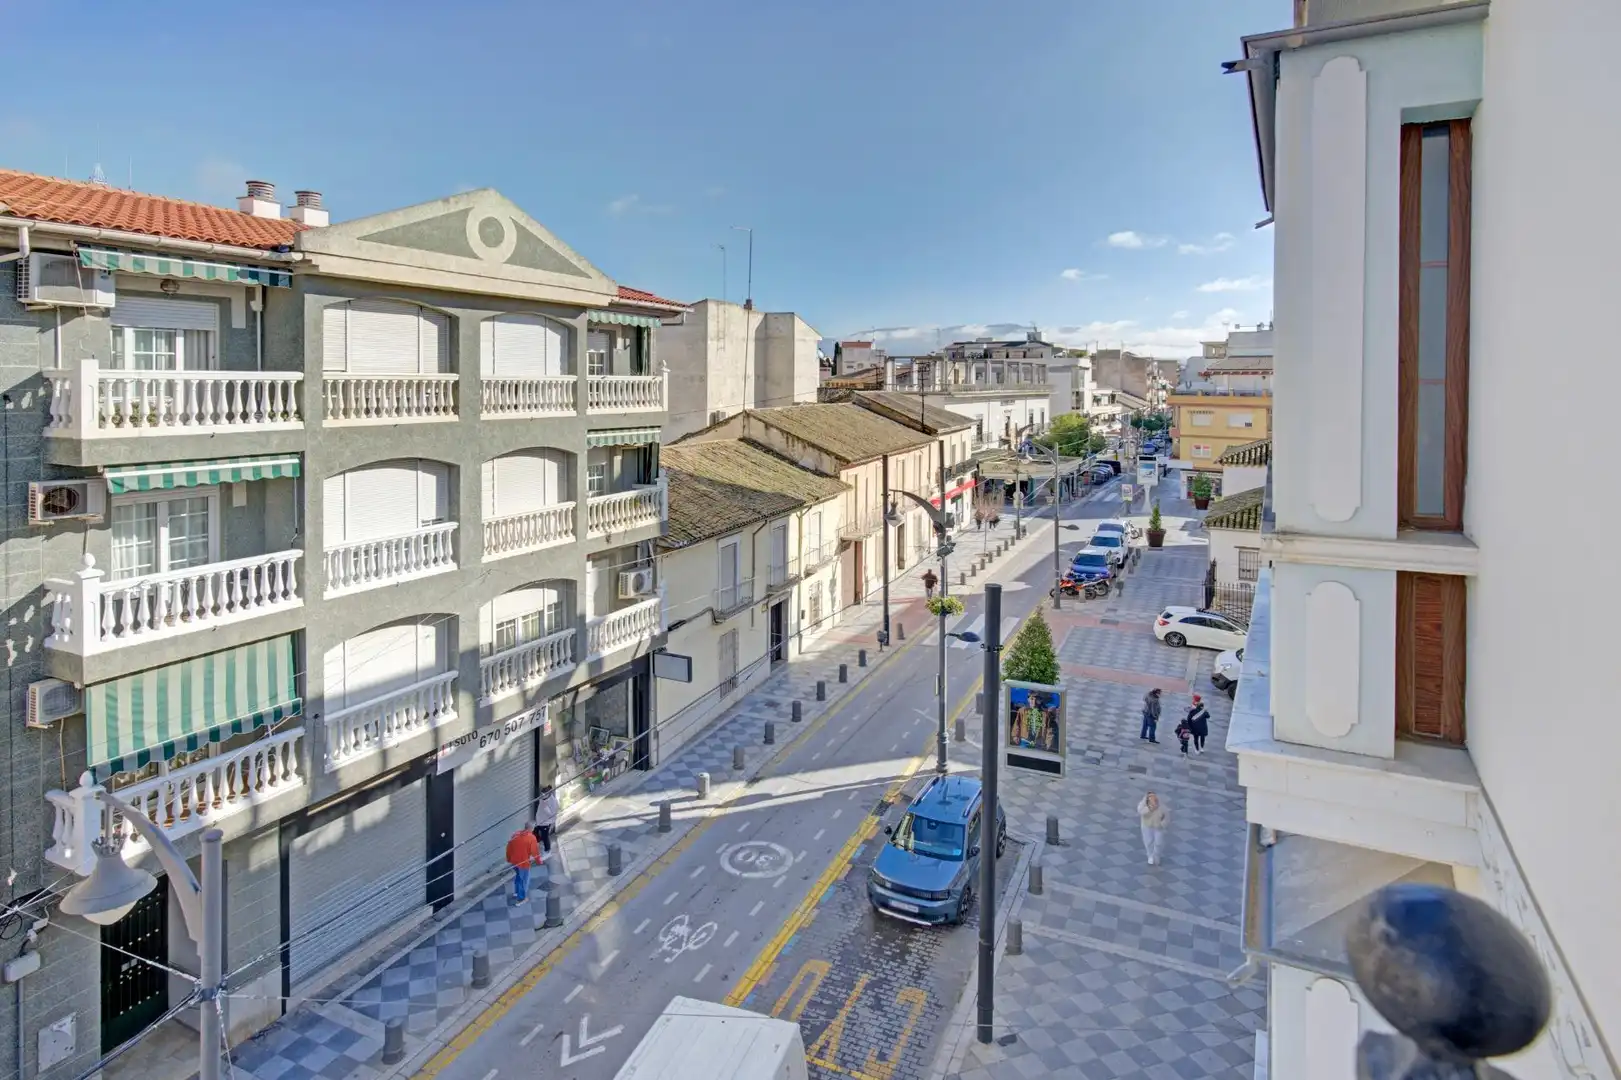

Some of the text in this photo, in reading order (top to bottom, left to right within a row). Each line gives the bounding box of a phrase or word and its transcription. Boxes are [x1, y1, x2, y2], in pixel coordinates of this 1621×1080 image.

[480, 729, 500, 748] 670
[504, 717, 525, 735] 507
[530, 706, 546, 724] 757
[736, 848, 779, 869] 30
